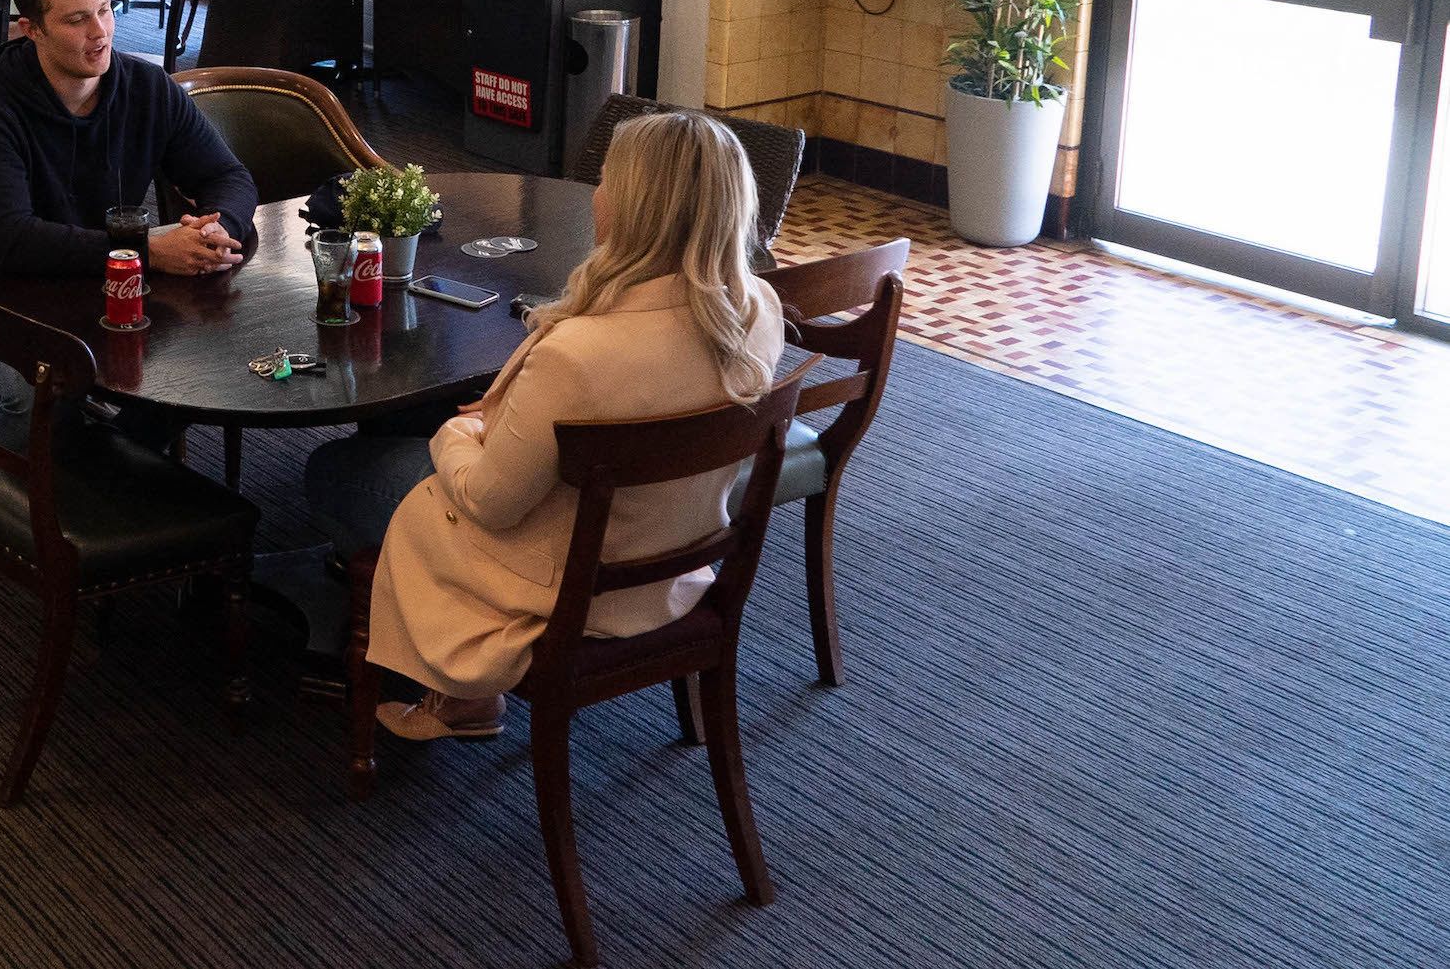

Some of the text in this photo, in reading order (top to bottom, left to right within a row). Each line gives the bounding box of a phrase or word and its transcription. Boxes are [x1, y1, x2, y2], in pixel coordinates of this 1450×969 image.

[475, 71, 528, 96] STAFF DO NOT
[475, 84, 528, 110] HAVE ACCESS
